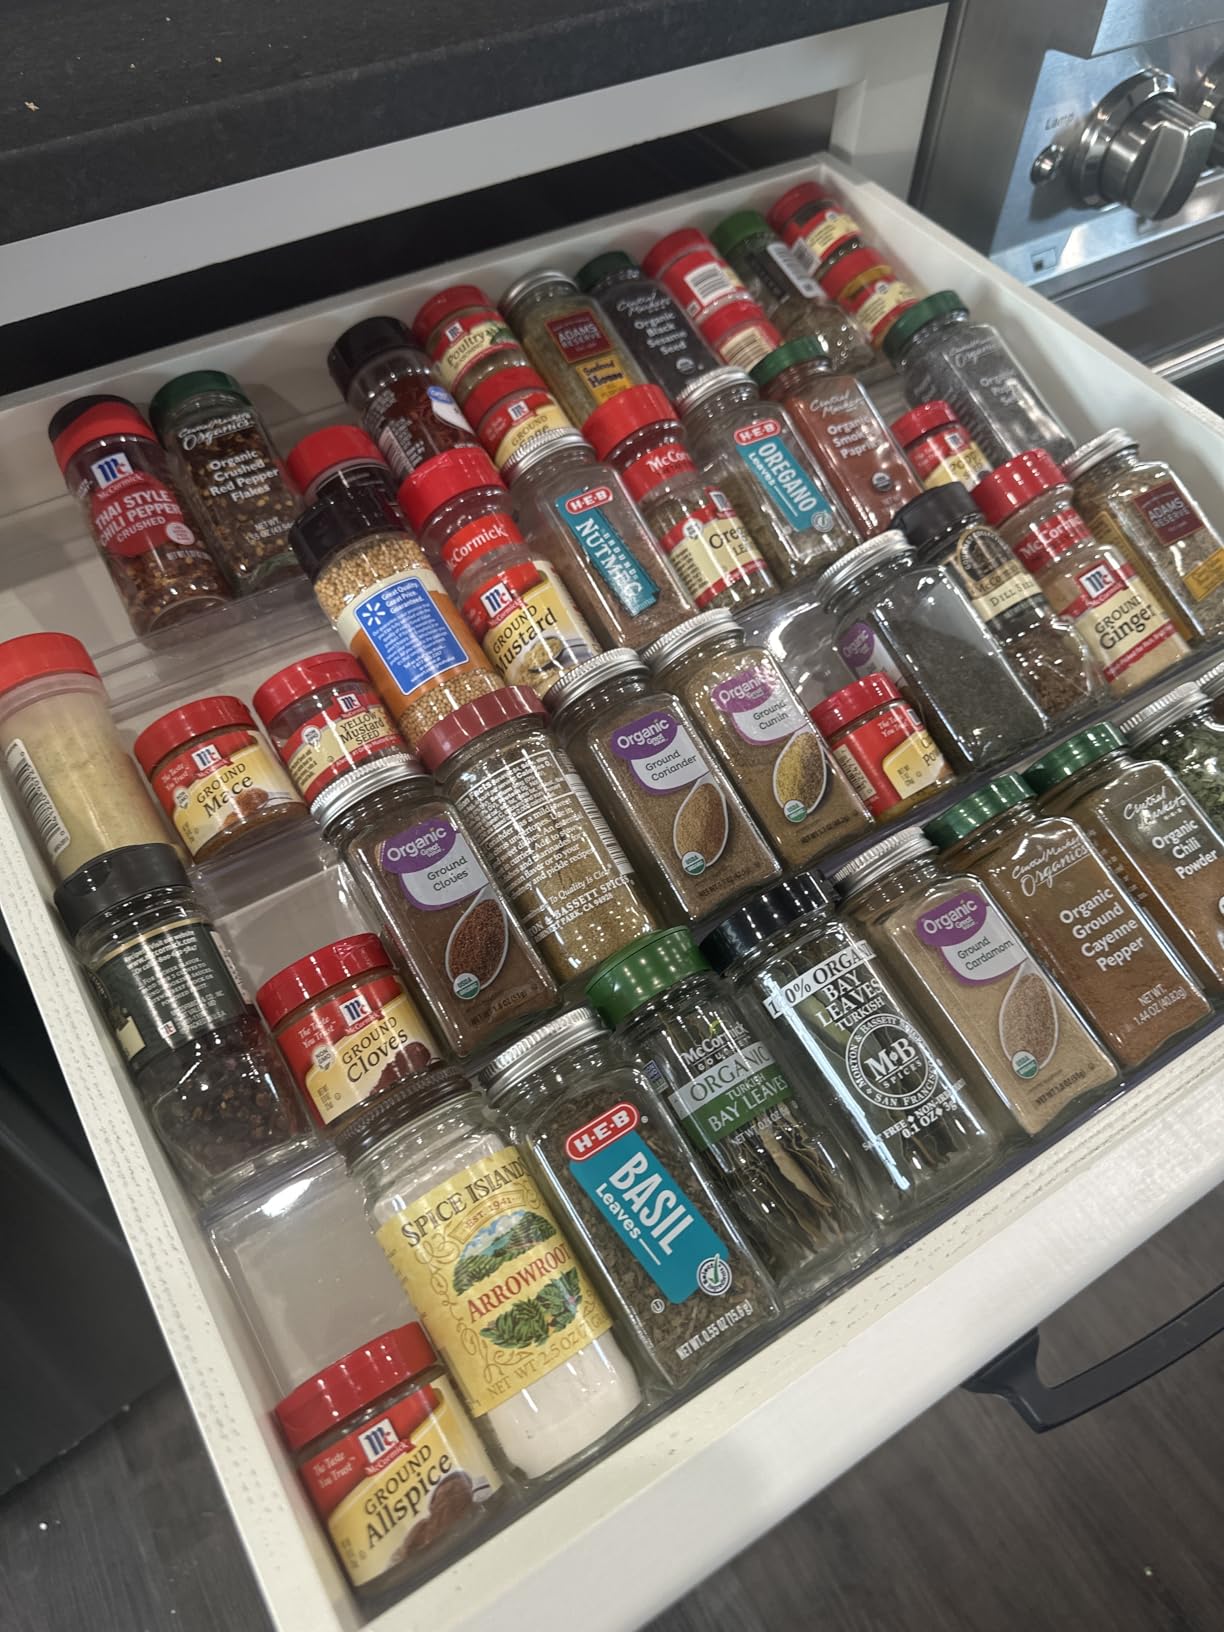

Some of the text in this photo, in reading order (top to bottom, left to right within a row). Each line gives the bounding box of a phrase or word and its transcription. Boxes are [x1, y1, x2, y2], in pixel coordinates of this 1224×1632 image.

[510, 414, 548, 447] GROUND
[209, 450, 259, 471] Organic
[213, 458, 266, 482] Crushed
[748, 452, 776, 487] Leaves
[758, 442, 817, 512] OREGANO
[209, 468, 280, 497] Red Pepper
[231, 484, 271, 502] Flakes
[96, 489, 173, 529] THAI STYLE
[100, 502, 182, 547] CHILI PEPPER
[1148, 497, 1184, 520] ADAMS
[117, 515, 166, 543] CRUSHED
[492, 604, 538, 655] GROUND
[1099, 602, 1157, 651] Ginger
[339, 711, 377, 732] YELLOW
[752, 701, 787, 722] Ground
[758, 713, 789, 731] Cumin
[340, 719, 386, 745] Mustard
[355, 730, 381, 746] SEED
[617, 718, 670, 749] Organic
[645, 750, 681, 772] Ground
[651, 755, 698, 782] Coriander
[196, 762, 247, 805] GROUND
[202, 775, 254, 819] Mace
[386, 825, 448, 862] Organic
[1152, 818, 1198, 849] Organic
[1172, 836, 1202, 860] Chili
[427, 856, 468, 882] Ground
[432, 869, 469, 893] Cloves
[1174, 848, 1218, 880] Powder
[923, 898, 978, 935] Organic
[1059, 887, 1116, 925] Organic
[1071, 902, 1126, 940] Ground
[957, 937, 991, 960] Ground
[1080, 918, 1139, 958] Cayenne
[1095, 936, 1145, 972] Pepper
[965, 939, 1015, 972] Cardamom
[815, 977, 884, 1028] LEAVES
[822, 969, 864, 1003] BAY
[835, 997, 885, 1032] TURKISH
[859, 1016, 898, 1034] BASSETT
[341, 1016, 397, 1065] GROUND
[346, 1029, 408, 1084] Cloves
[689, 1046, 772, 1103] ORGANIC
[882, 1060, 923, 1089] SPICES
[707, 1075, 789, 1133] BAY LEAVES
[874, 1094, 898, 1107] SAN
[882, 1119, 908, 1140] FREE
[901, 1122, 921, 1139] 0.1
[919, 1110, 939, 1128] OZ
[401, 1192, 468, 1248] SPICE
[595, 1183, 641, 1240] Leaves
[609, 1151, 694, 1256] BASIL
[675, 1342, 693, 1360] NET
[701, 1323, 720, 1342] 0.55
[486, 1378, 513, 1398] NET
[516, 1361, 538, 1380] WT
[363, 1444, 433, 1516] GROUND
[366, 1454, 453, 1550] Allspice
